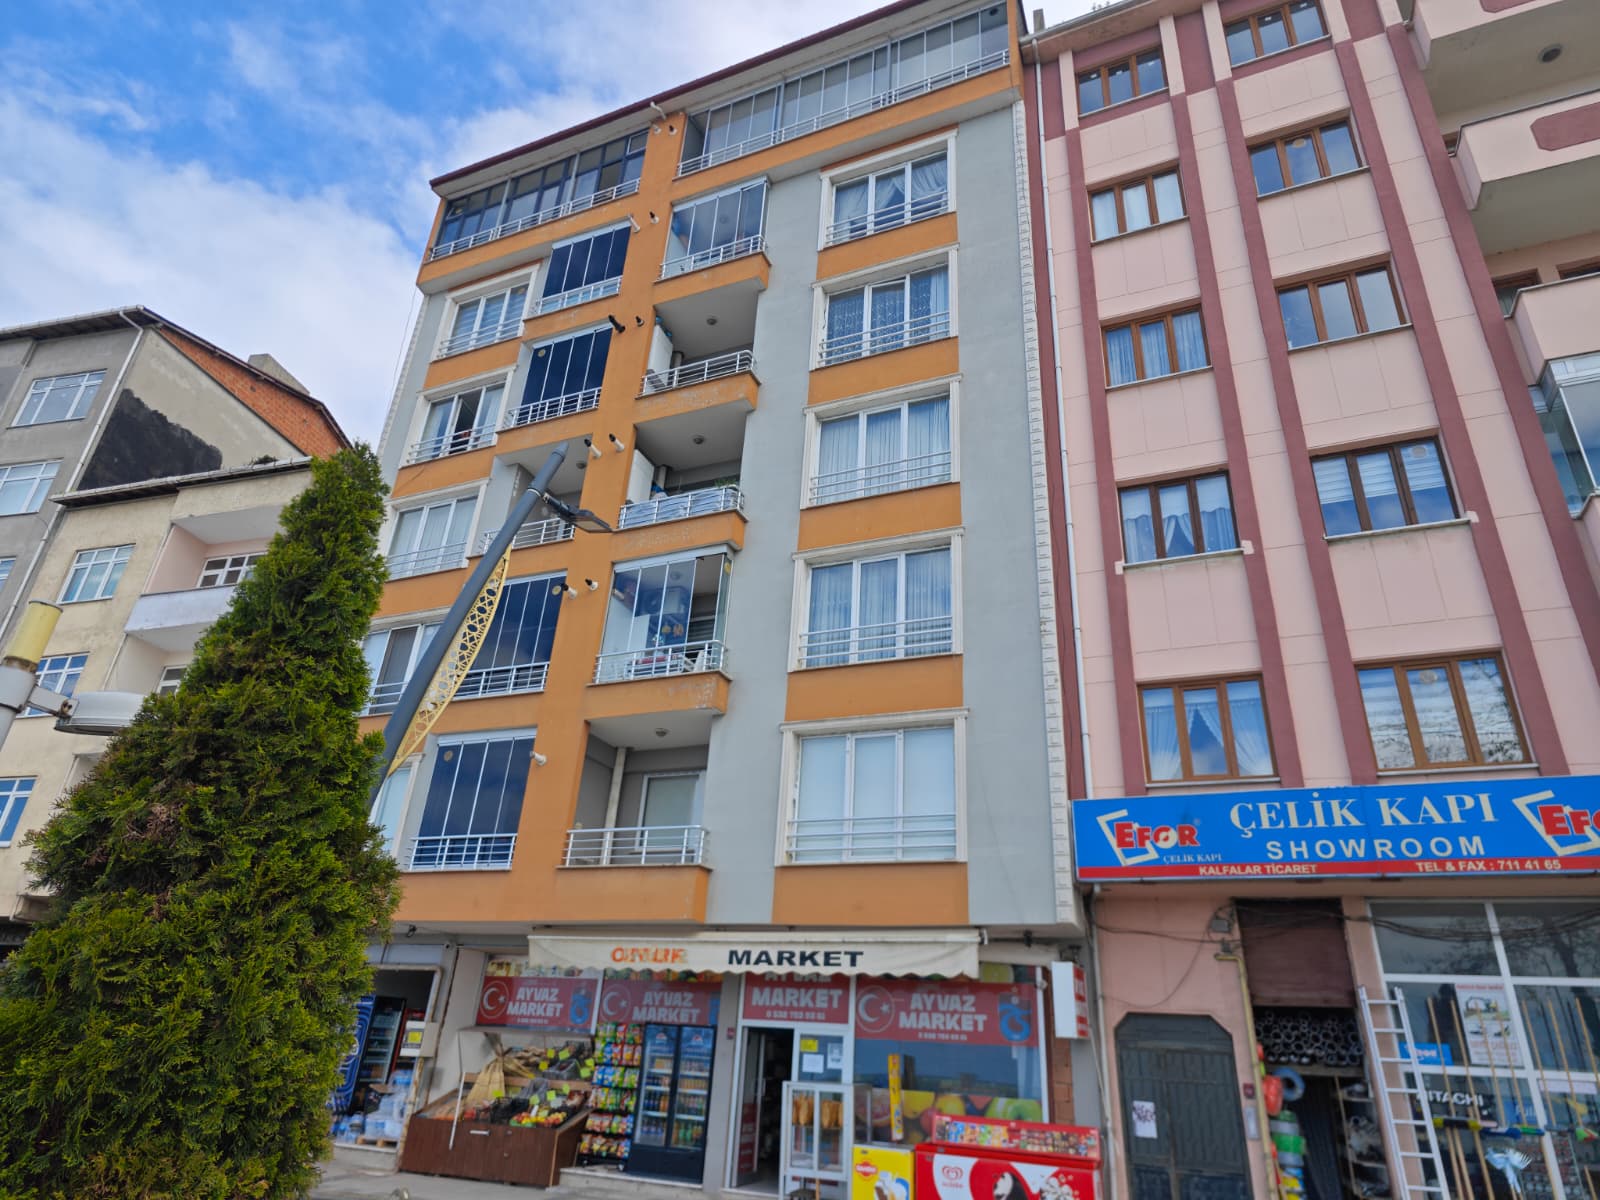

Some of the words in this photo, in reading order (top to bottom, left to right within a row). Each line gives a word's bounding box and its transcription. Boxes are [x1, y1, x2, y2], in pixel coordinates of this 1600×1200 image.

[1229, 791, 1366, 839] ÇELİK
[1376, 792, 1500, 827] KAPI
[1114, 821, 1201, 850] EFOR
[1265, 835, 1487, 861] SHOWROOM
[1196, 852, 1223, 863] KAPI
[1415, 861, 1444, 873] TEL
[1445, 859, 1456, 872] &
[1458, 858, 1488, 872] FAX
[1497, 858, 1521, 870] 711
[1524, 858, 1541, 870] 41
[1543, 858, 1562, 870] 65
[1199, 863, 1263, 876] KALFALAR
[1265, 862, 1318, 875] TİCARET
[727, 949, 865, 968] MARKET
[515, 986, 560, 1002] AYVAZ
[641, 990, 695, 1007] AYVAZ
[750, 986, 843, 1009] MARKET
[910, 992, 977, 1012] AYVAZ
[506, 1001, 564, 1017] MARKET
[631, 1006, 701, 1024] MARKET
[898, 1011, 988, 1033] MARKET
[1417, 1090, 1485, 1107] ITACHI
